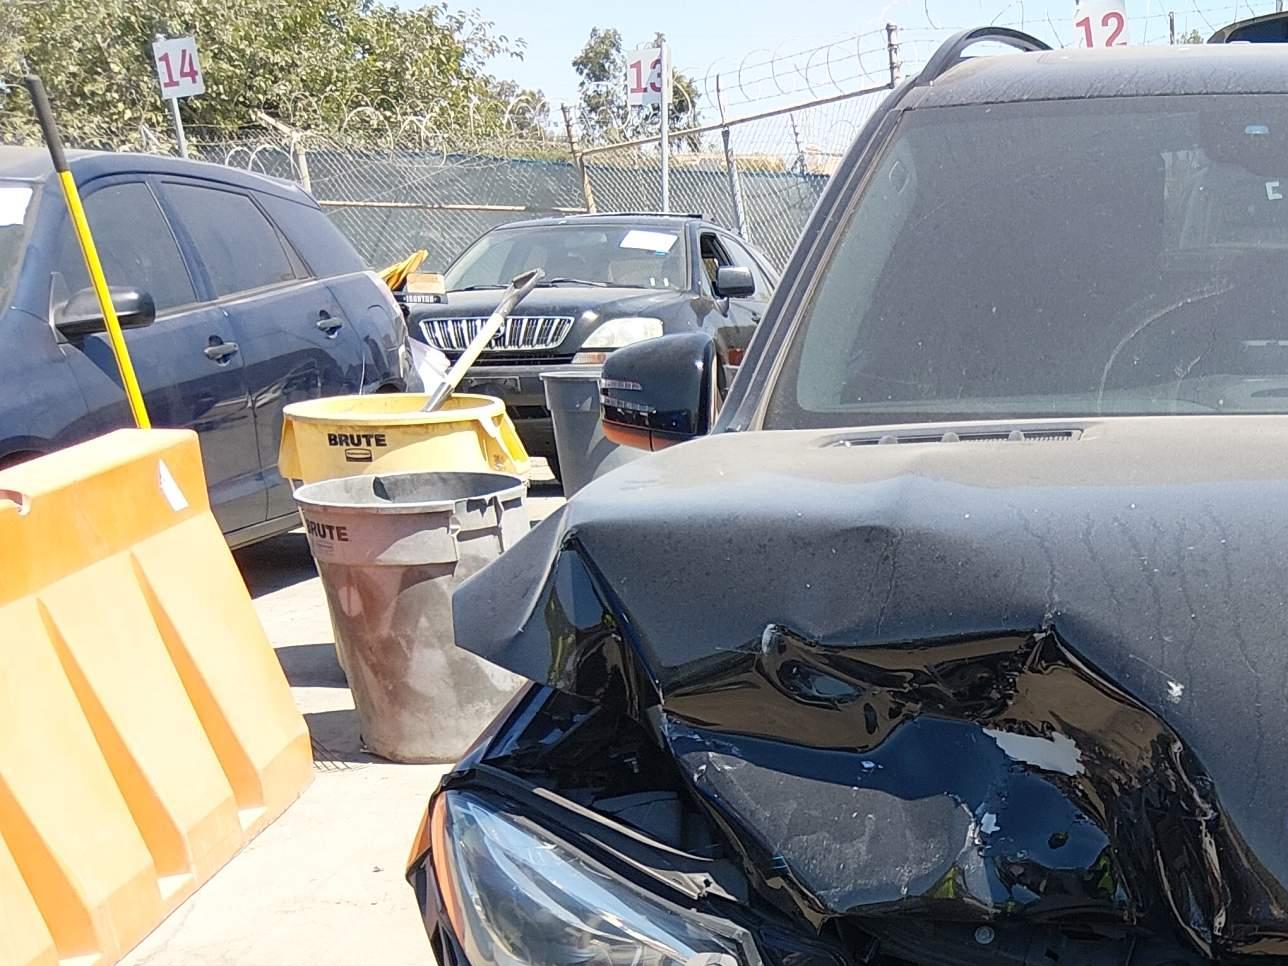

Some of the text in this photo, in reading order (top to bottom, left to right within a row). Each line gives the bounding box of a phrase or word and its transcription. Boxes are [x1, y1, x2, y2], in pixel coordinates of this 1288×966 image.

[1075, 11, 1124, 48] 12
[158, 49, 198, 88] 14
[327, 433, 387, 447] BRUTE
